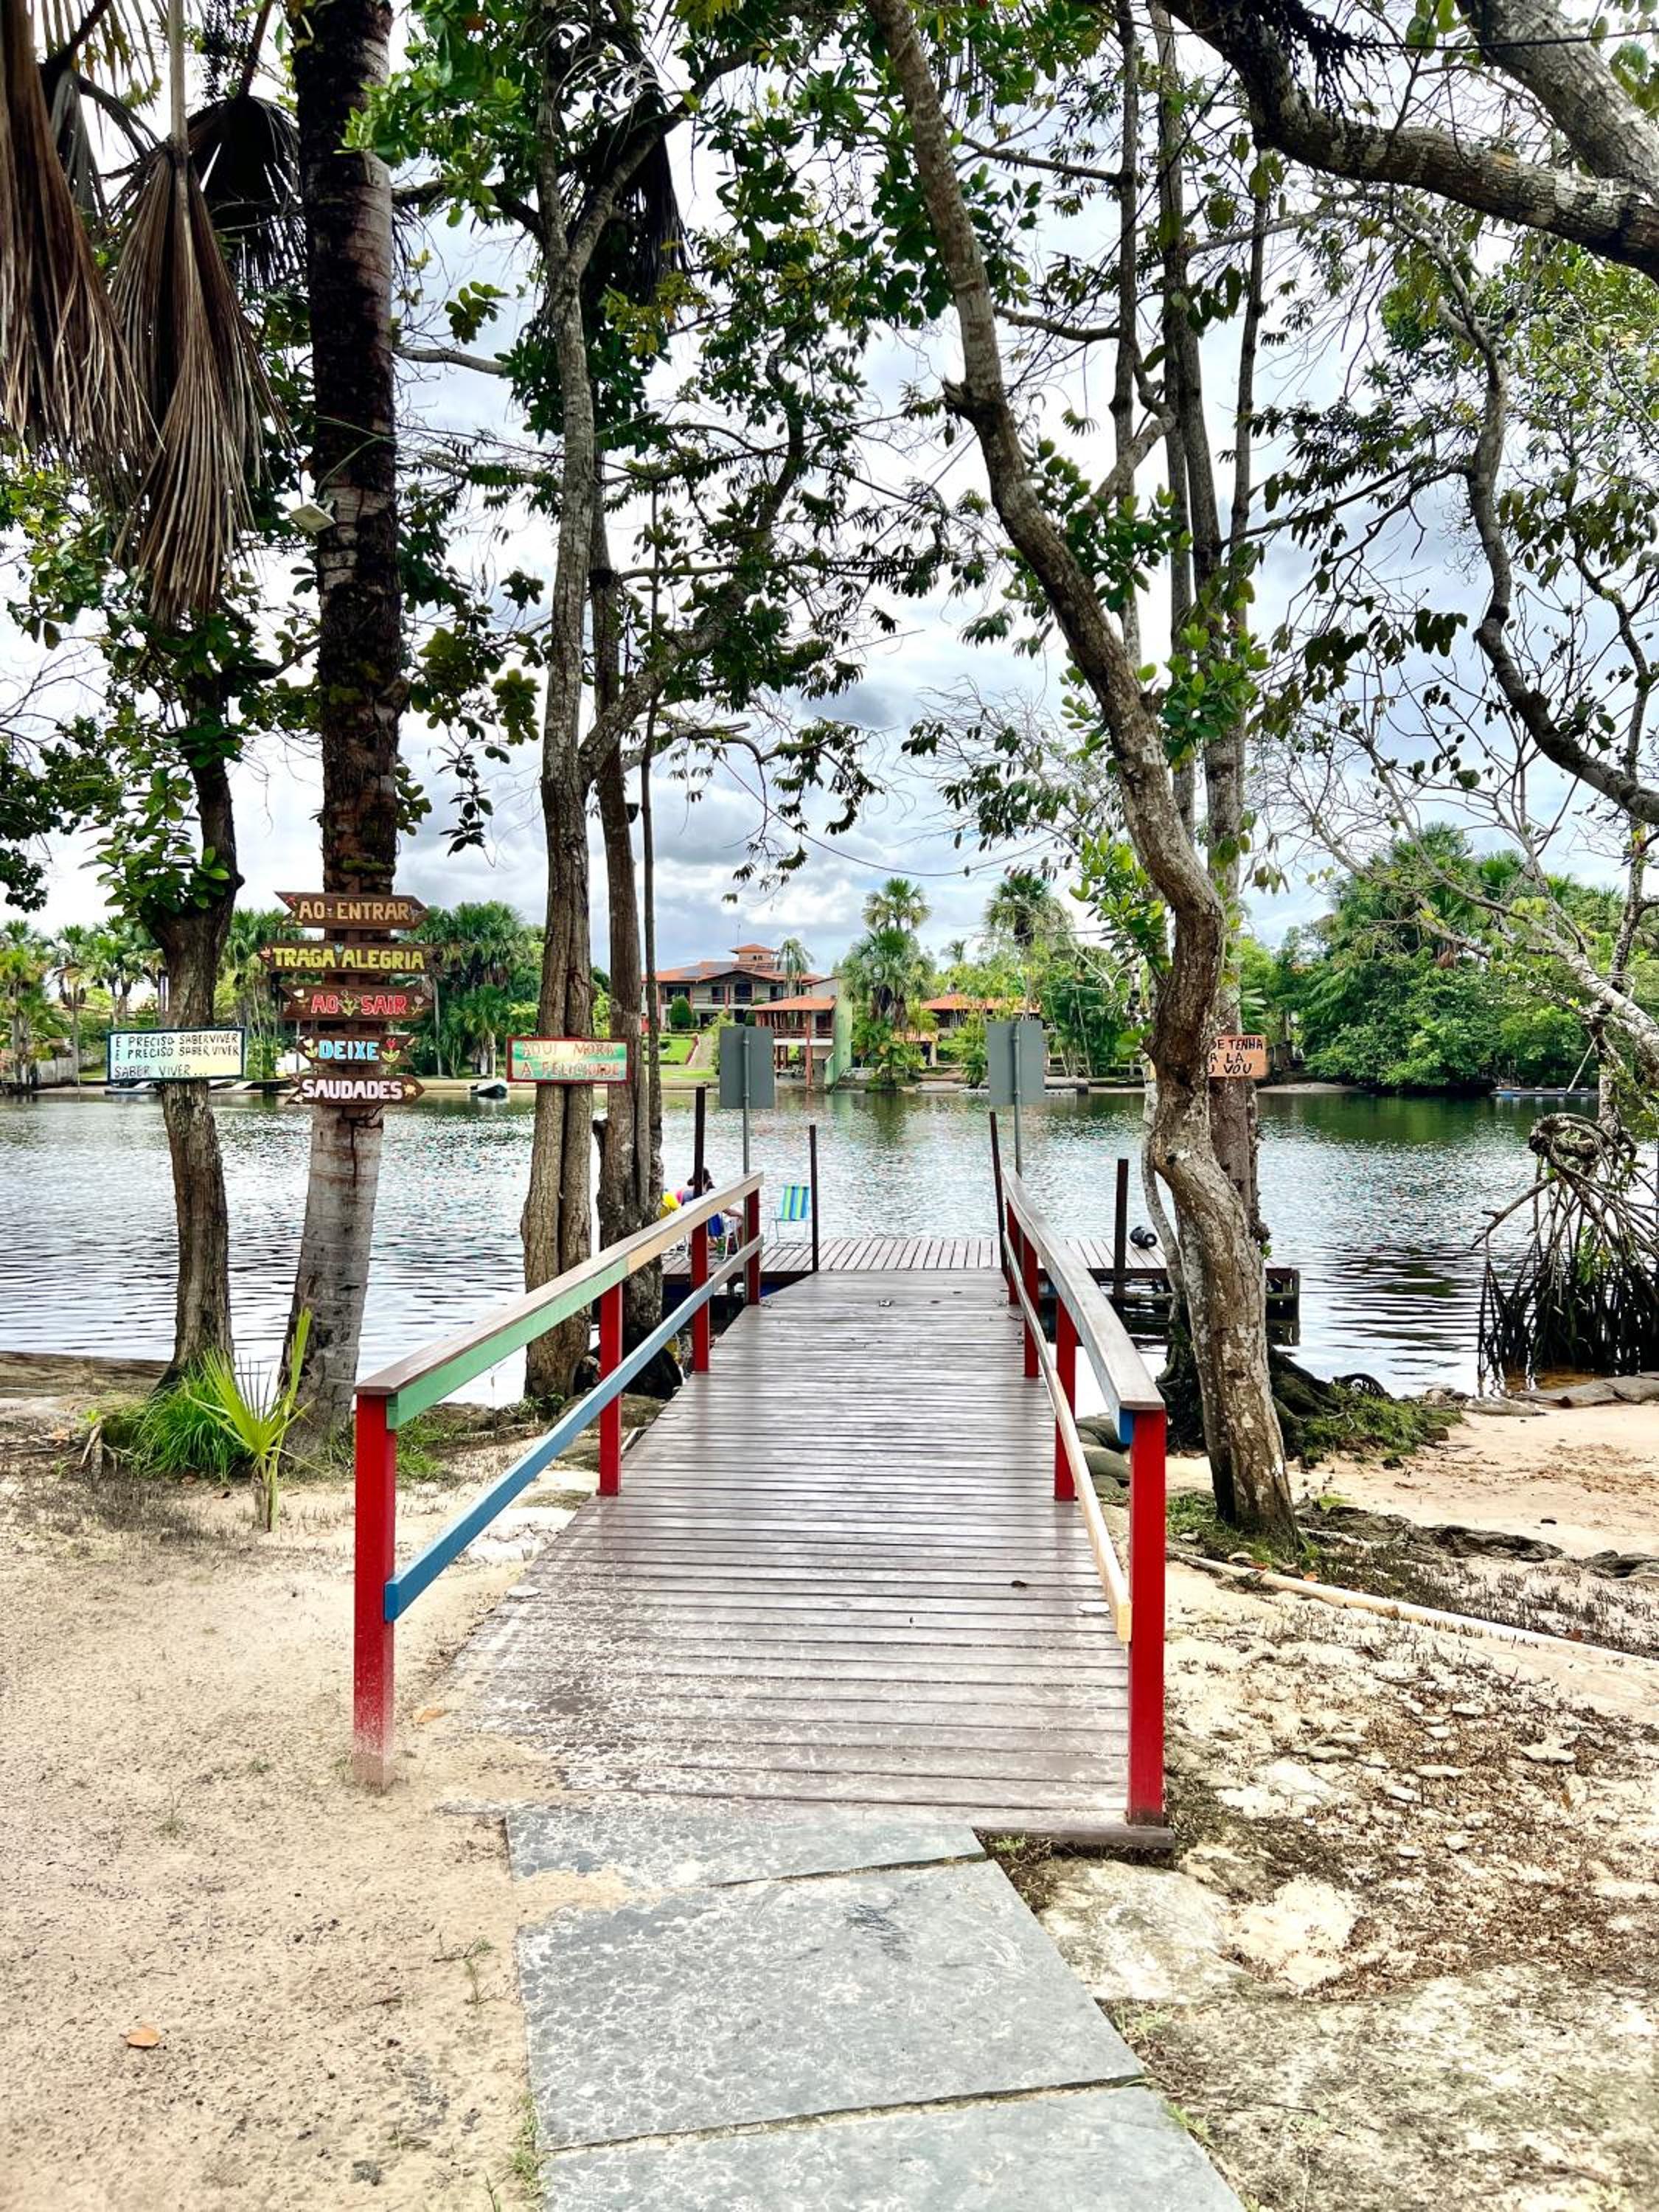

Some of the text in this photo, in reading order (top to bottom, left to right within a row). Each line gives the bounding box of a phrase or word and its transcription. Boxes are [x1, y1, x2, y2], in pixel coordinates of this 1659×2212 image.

[299, 901, 410, 921] AO ENTRAR
[273, 947, 425, 970] TRAGA ALEGRIA
[310, 995, 338, 1014] AO
[128, 1035, 175, 1048] PRECISO
[1228, 1038, 1263, 1051] TENHA
[128, 1046, 174, 1059] PRECISO
[178, 1045, 209, 1057] SABER
[212, 1045, 240, 1057] VIVER
[318, 1040, 380, 1062] DEIXE
[114, 1065, 150, 1078] SABER
[1223, 1063, 1252, 1074] VOU
[302, 1079, 403, 1100] SAUDADES
